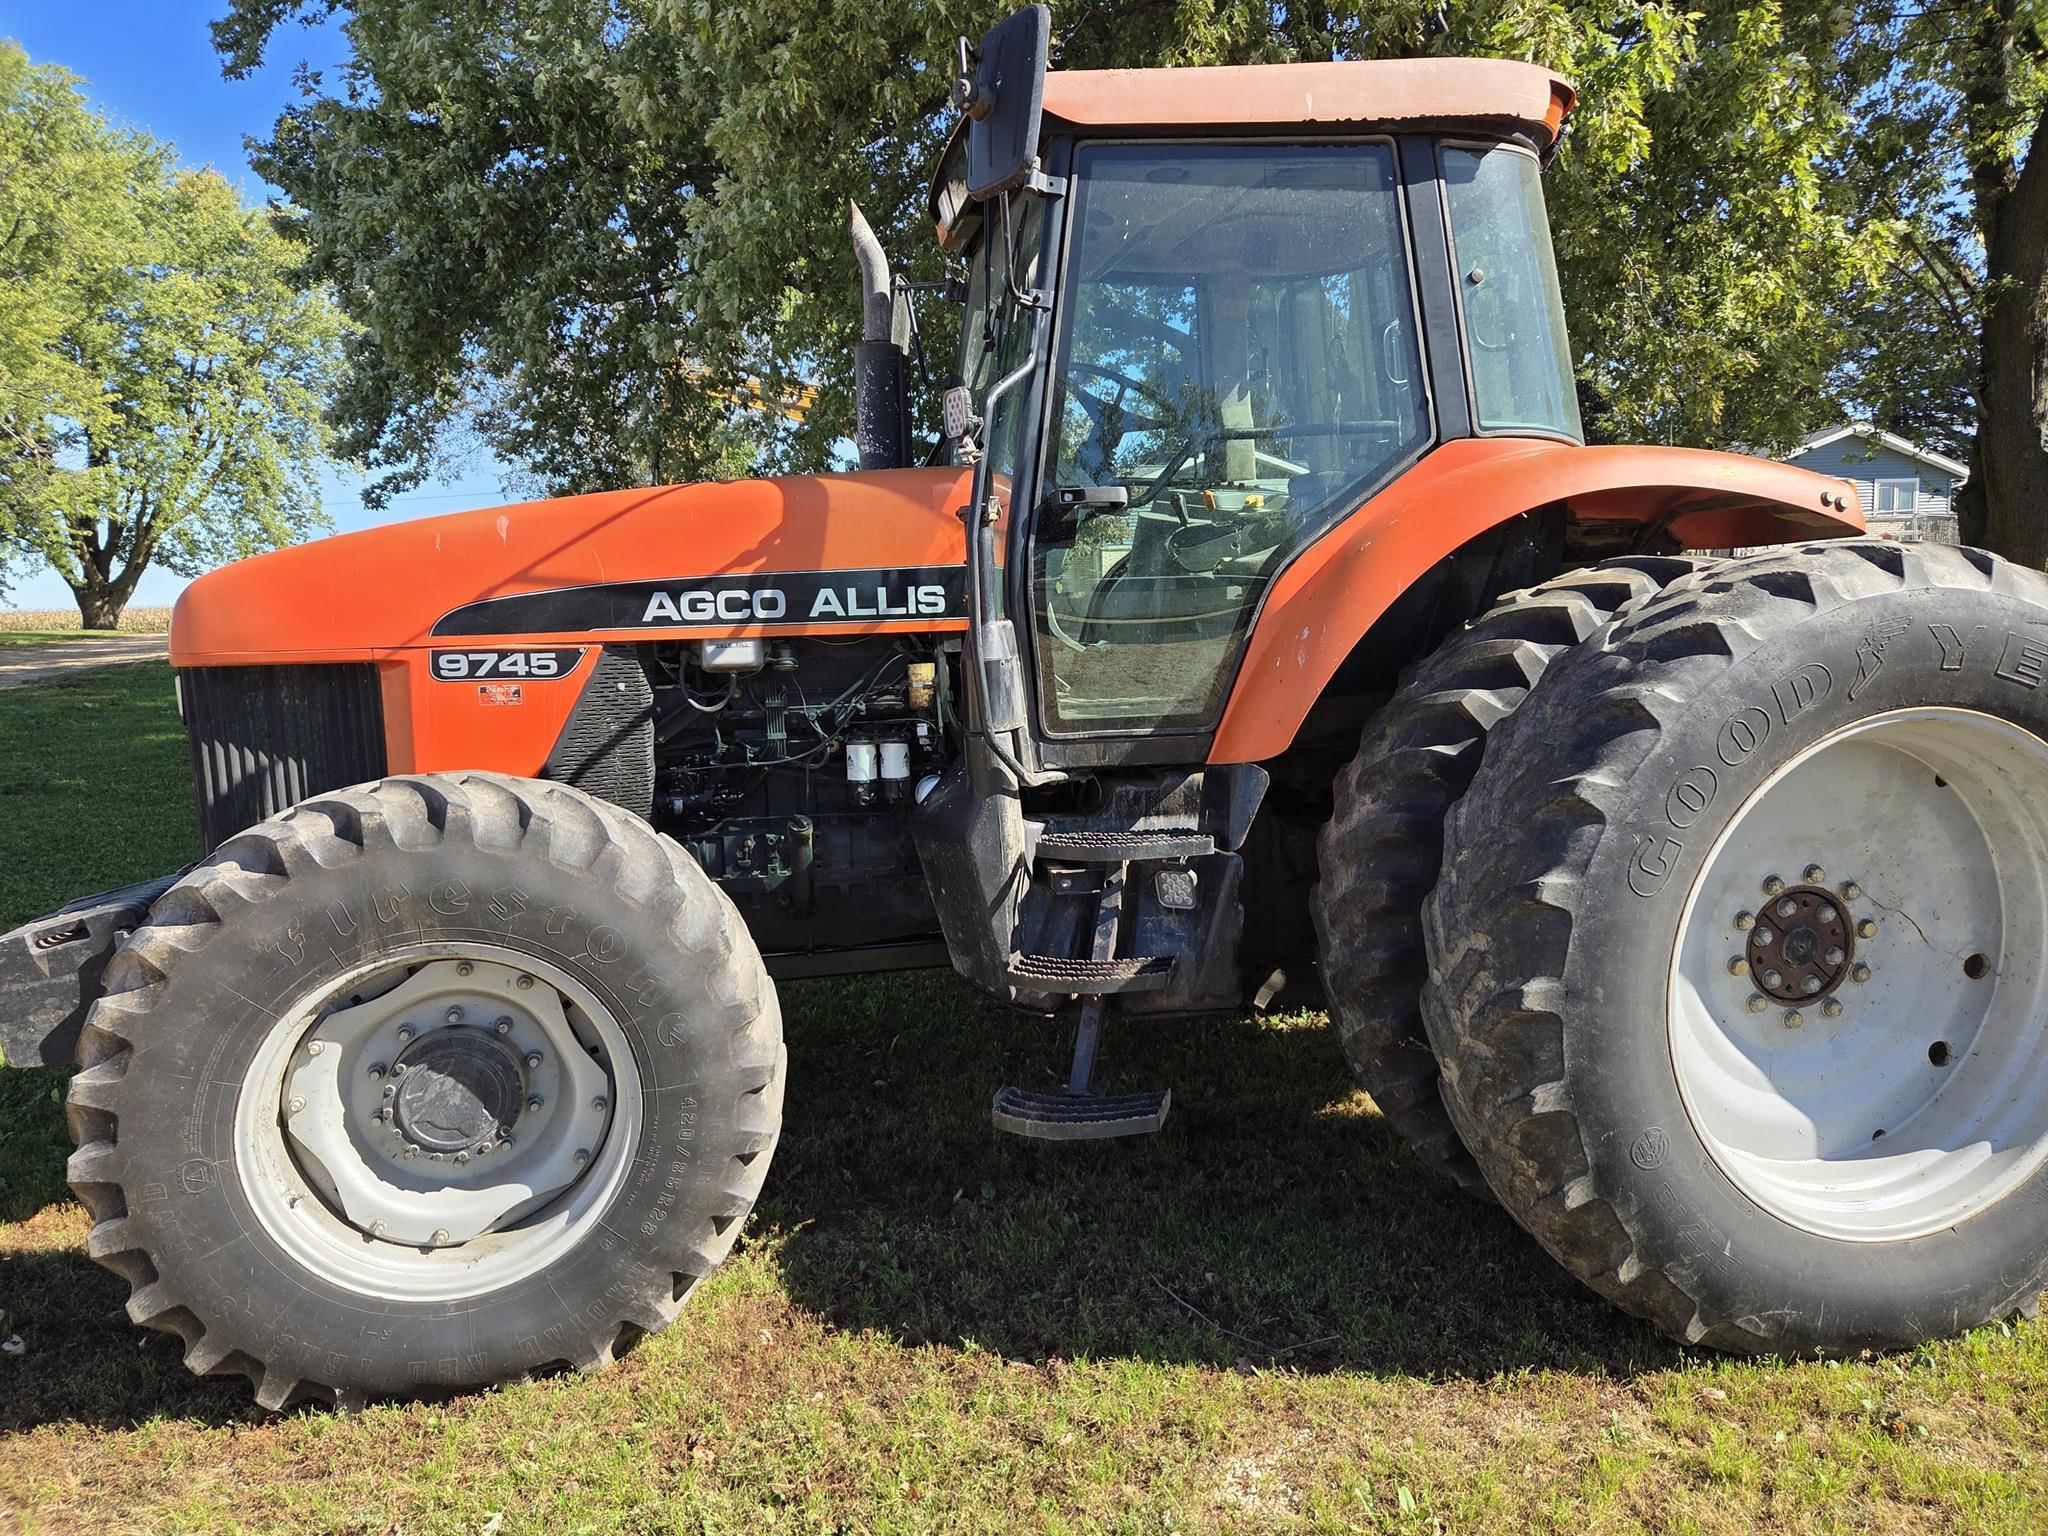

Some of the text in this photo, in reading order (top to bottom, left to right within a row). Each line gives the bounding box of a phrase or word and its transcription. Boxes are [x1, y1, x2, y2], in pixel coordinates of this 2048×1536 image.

[642, 584, 946, 622] AGCO ALLIS
[438, 652, 558, 677] 9745
